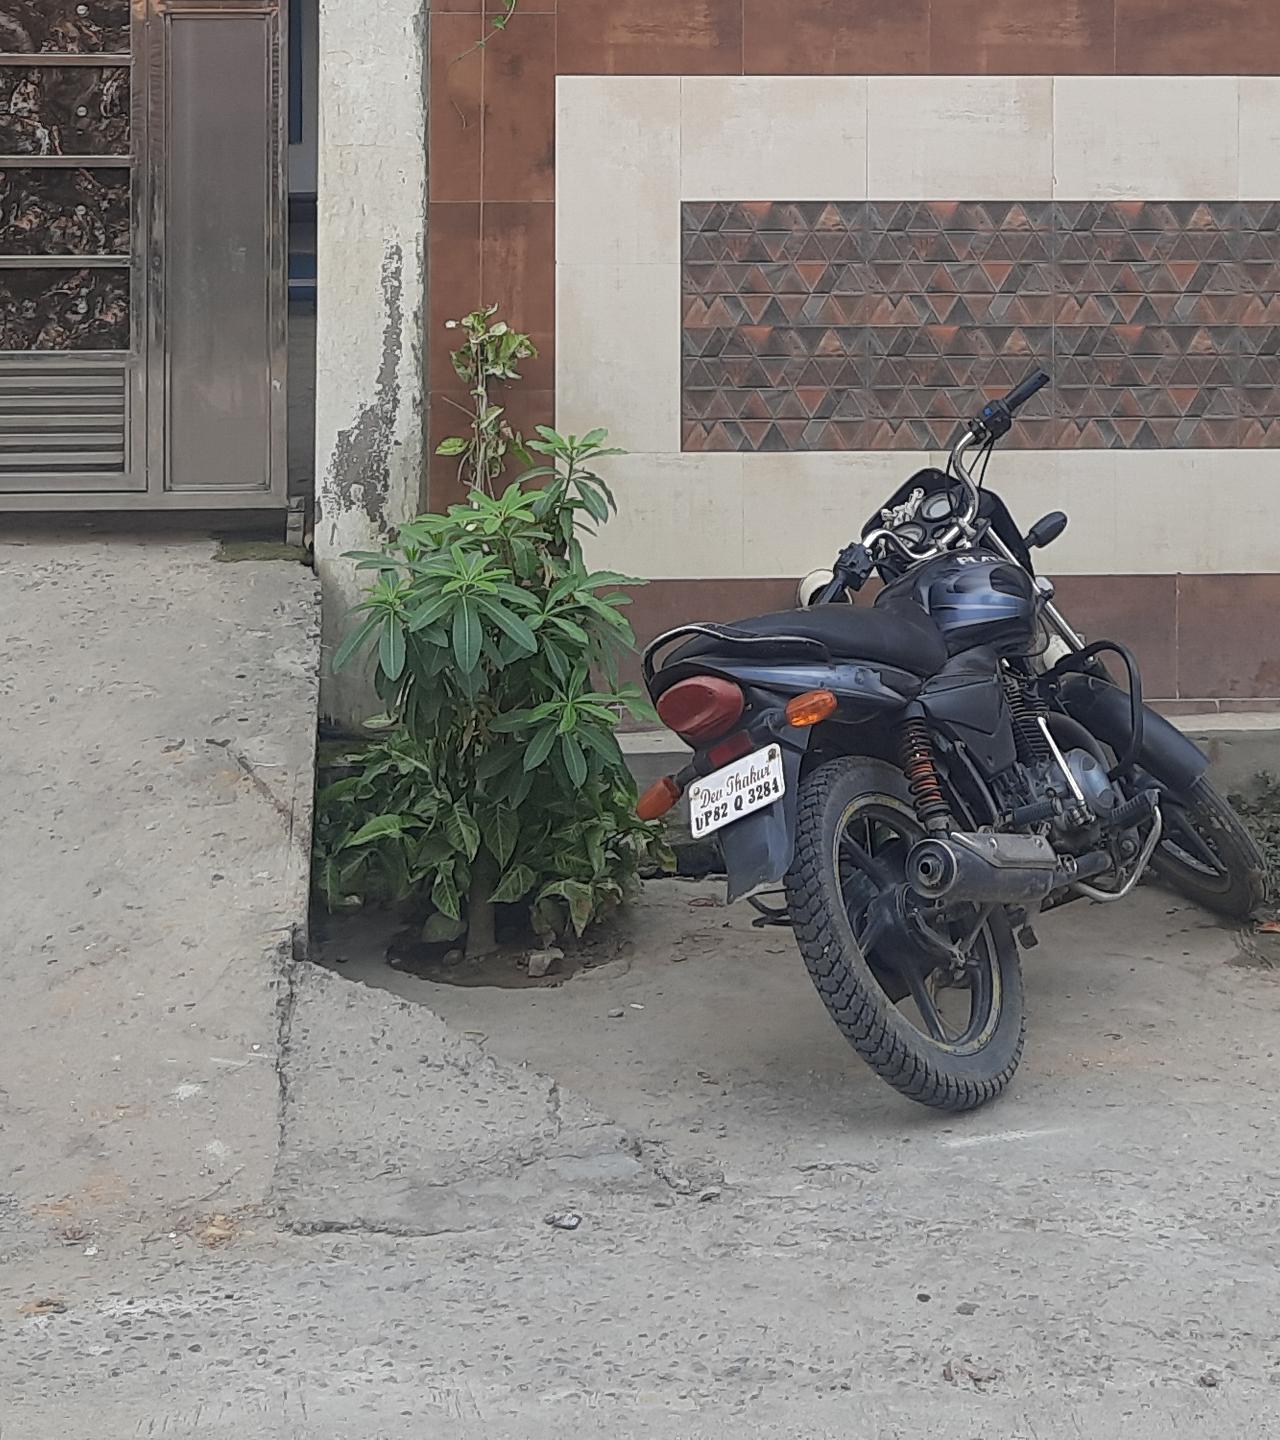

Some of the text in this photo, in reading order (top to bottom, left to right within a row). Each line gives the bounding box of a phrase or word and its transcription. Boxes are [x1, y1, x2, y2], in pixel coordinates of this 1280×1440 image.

[727, 765, 771, 796] Thakur
[696, 778, 780, 831] UP82 Q 3284
